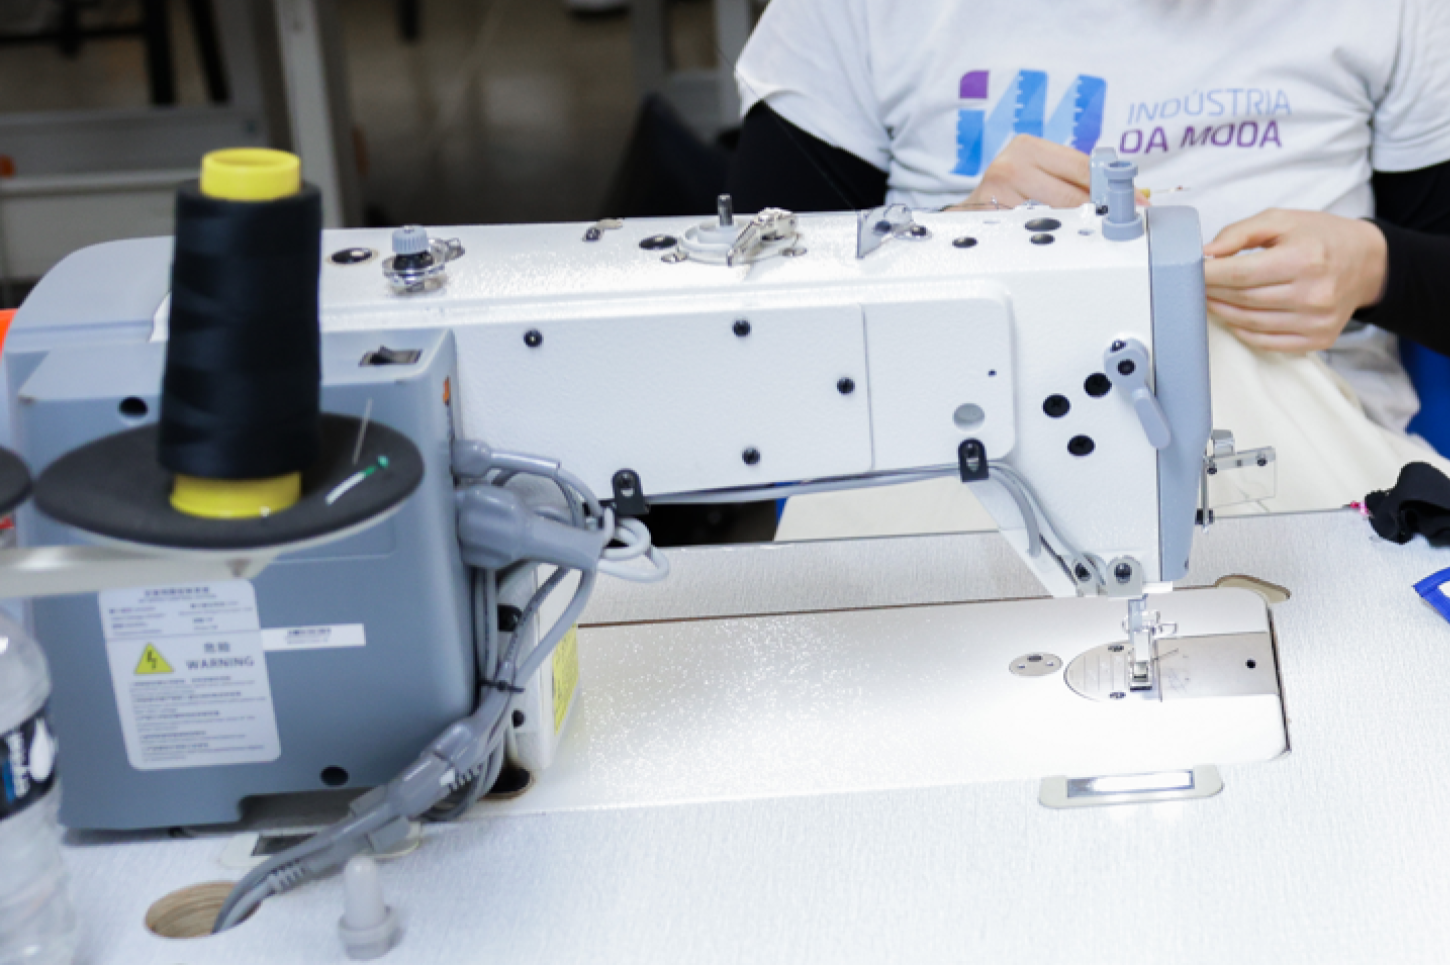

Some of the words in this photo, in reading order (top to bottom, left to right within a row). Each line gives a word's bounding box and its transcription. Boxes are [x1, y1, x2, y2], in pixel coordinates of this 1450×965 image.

[1127, 87, 1292, 125] INDÚSTRIA
[1119, 125, 1169, 154] DA
[1180, 119, 1282, 149] MODA
[186, 656, 255, 671] WARNING
